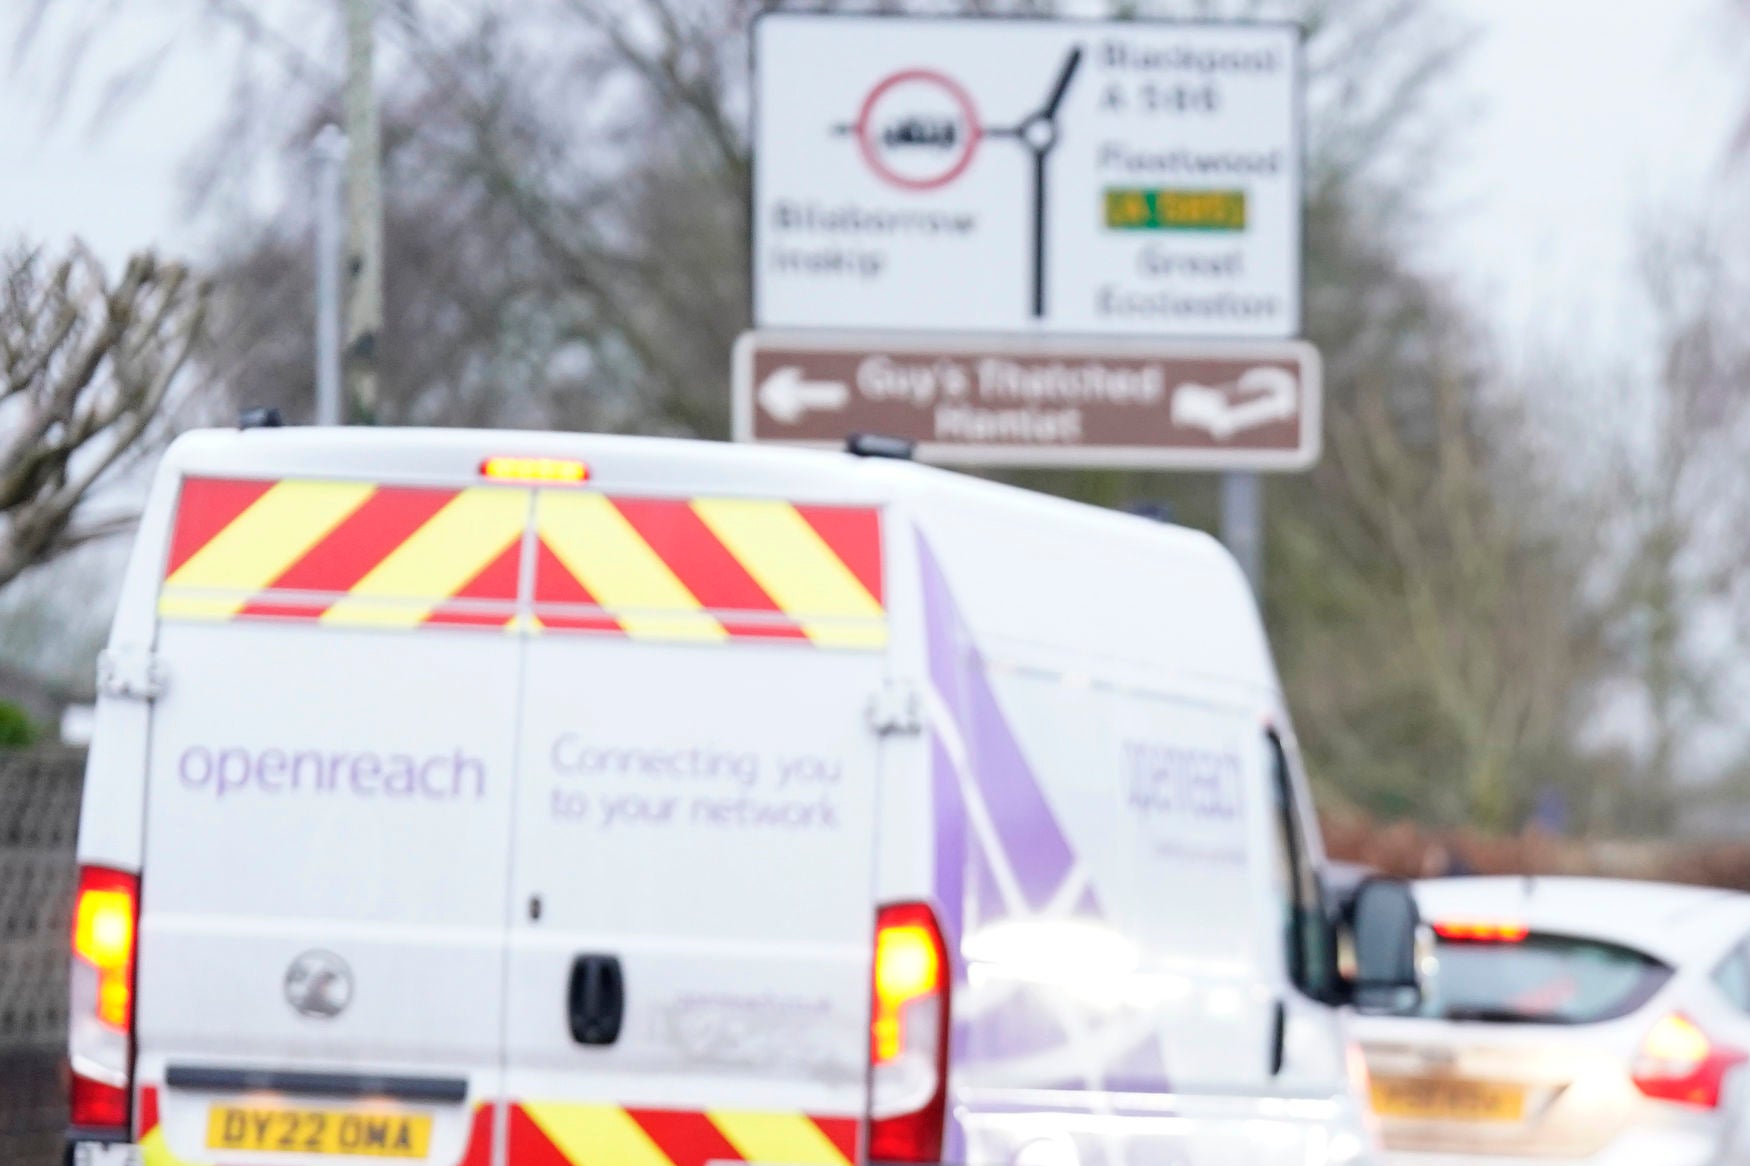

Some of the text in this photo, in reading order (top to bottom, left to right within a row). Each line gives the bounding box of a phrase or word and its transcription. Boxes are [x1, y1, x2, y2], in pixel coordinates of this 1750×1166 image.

[1101, 41, 1278, 74] Blackpool
[1098, 142, 1280, 174] Fleetwood
[1137, 243, 1244, 278] Great
[1096, 285, 1278, 318] Eccleston
[857, 355, 1164, 407] Guy's Thatched
[934, 402, 1082, 440] Hamlet
[178, 744, 485, 799] openreach
[549, 730, 842, 790] Connecting you
[549, 785, 840, 832] to your network
[223, 1107, 412, 1152] DY22 OMA
